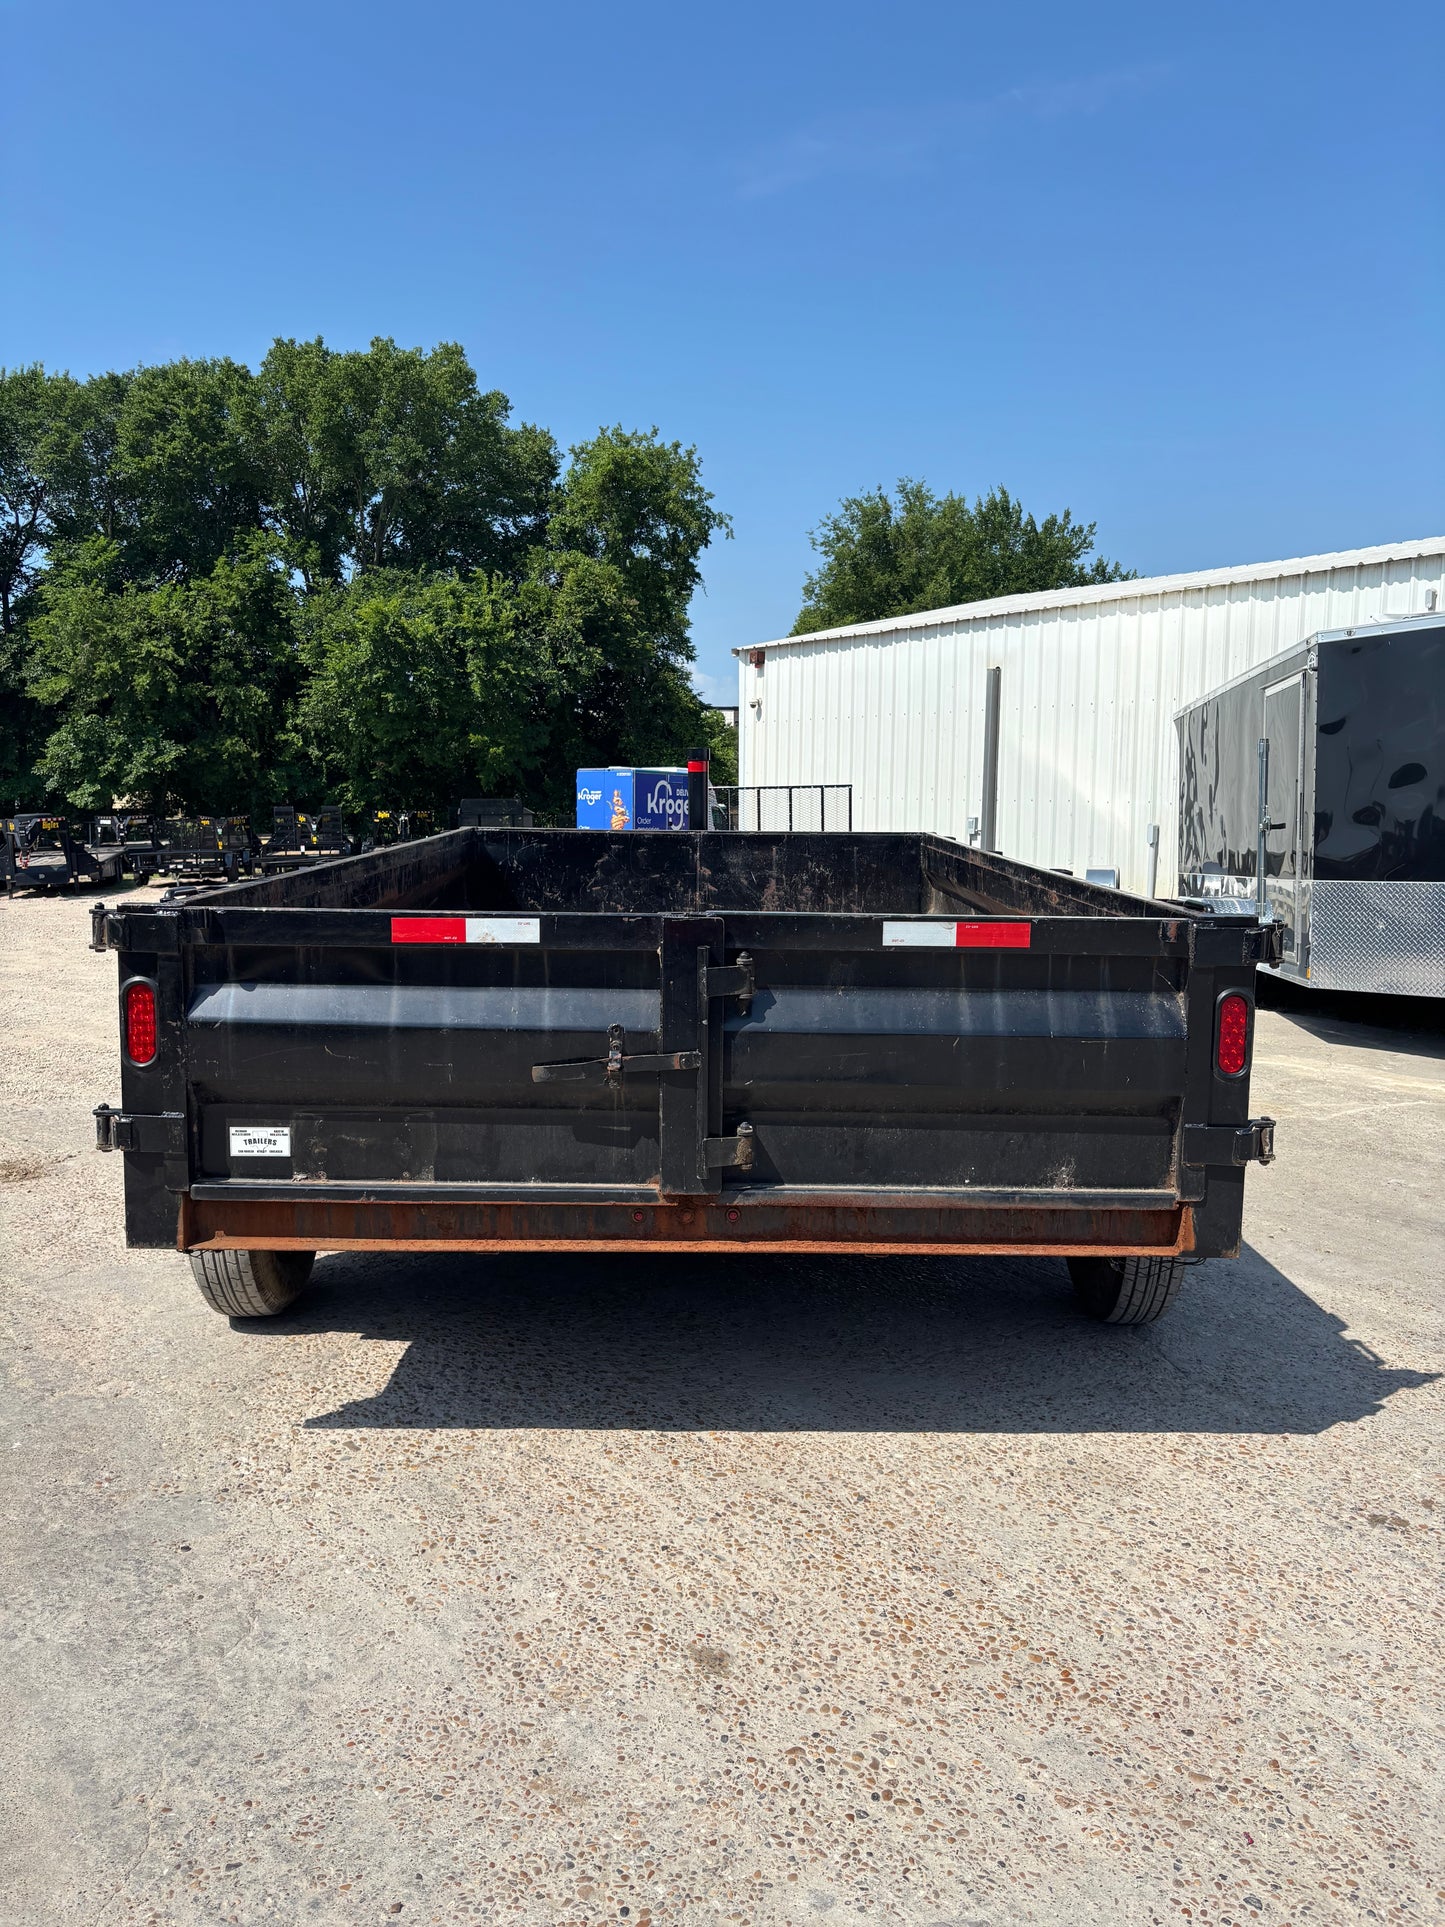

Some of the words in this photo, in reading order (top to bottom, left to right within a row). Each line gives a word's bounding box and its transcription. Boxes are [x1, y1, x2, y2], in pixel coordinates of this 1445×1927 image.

[577, 788, 602, 805] Kroger
[647, 780, 689, 831] Kroge
[637, 816, 652, 825] Order
[243, 1138, 277, 1146] TRAILERS
